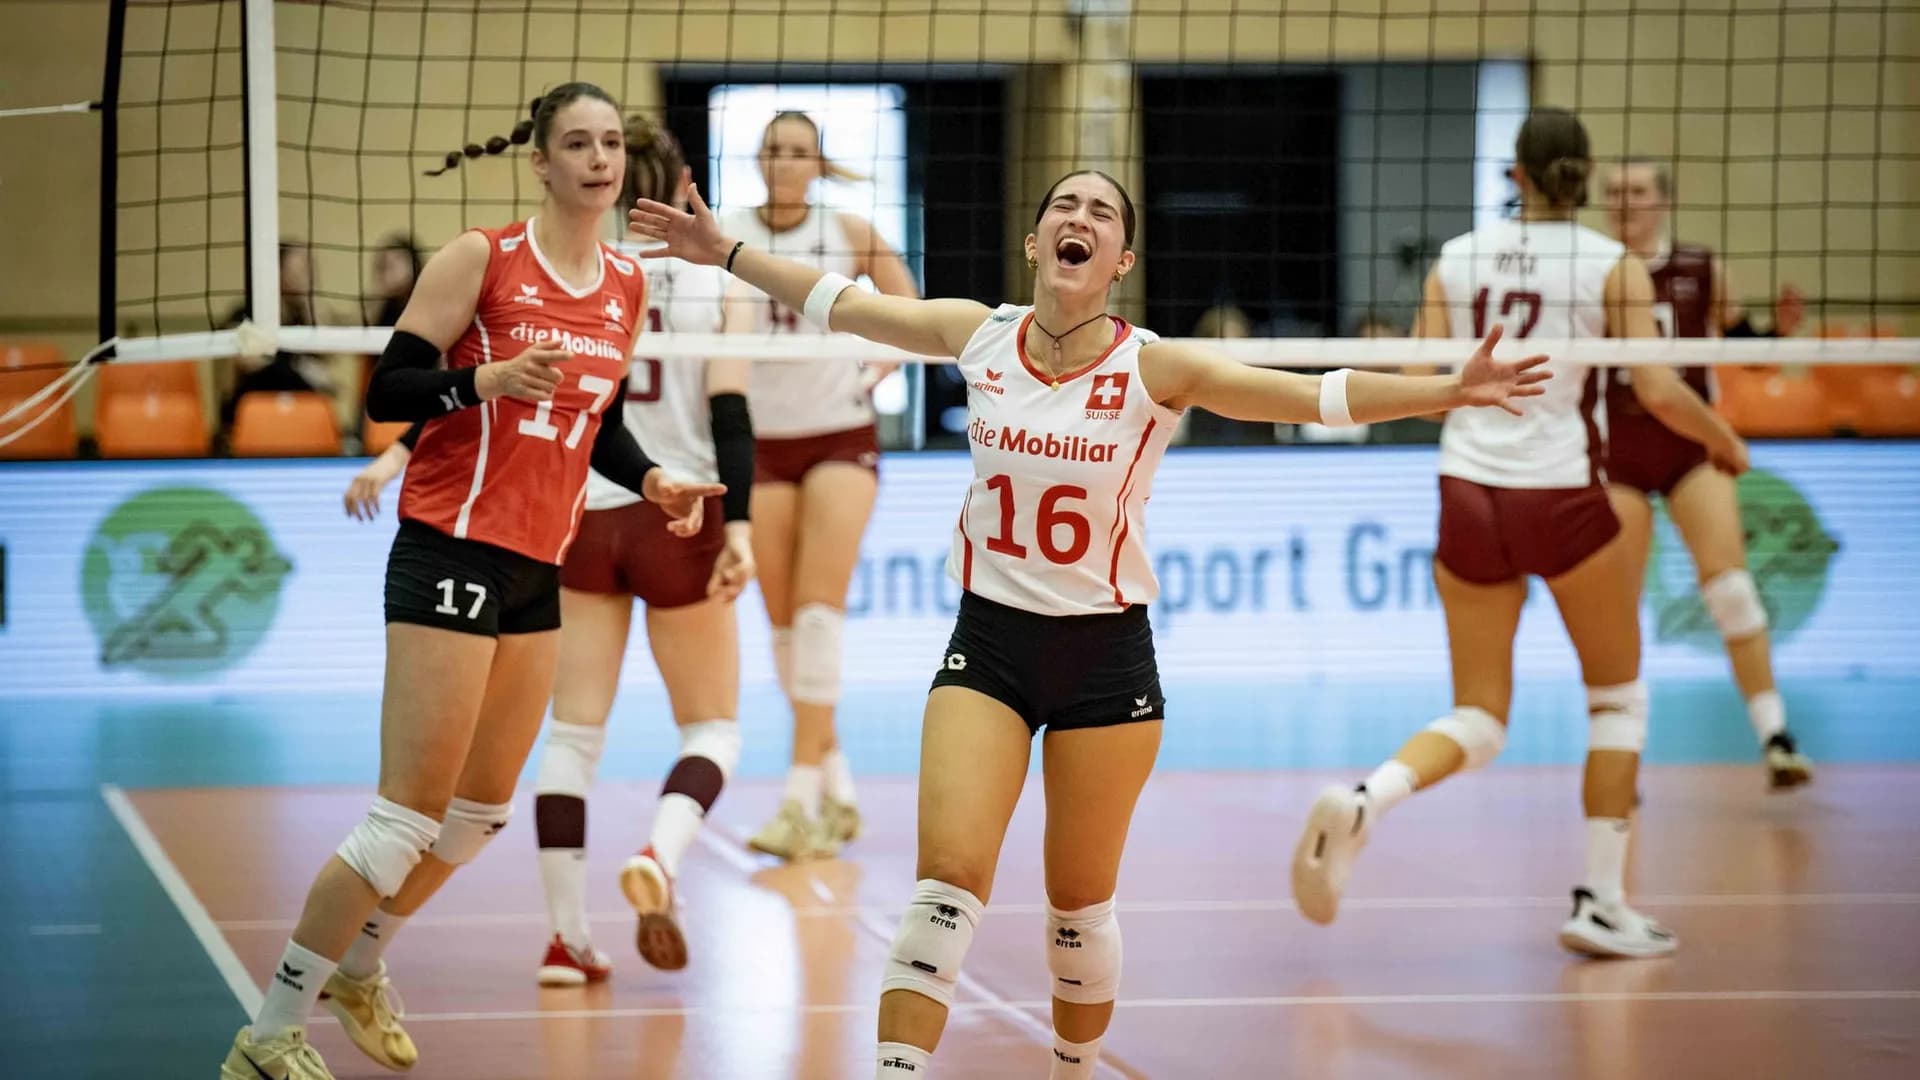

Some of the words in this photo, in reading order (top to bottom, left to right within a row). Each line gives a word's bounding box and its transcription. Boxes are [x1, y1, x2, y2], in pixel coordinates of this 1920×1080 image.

[510, 322, 549, 344] die
[973, 381, 1005, 396] erima
[517, 374, 614, 450] 17
[1085, 410, 1121, 421] SUISSE
[971, 417, 997, 448] die
[998, 426, 1119, 463] Mobiliar
[985, 473, 1091, 566] 16
[1155, 534, 1310, 632] port
[435, 578, 487, 619] 17
[1131, 705, 1153, 718] erima
[930, 914, 957, 930] errea
[1055, 937, 1082, 949] errea
[882, 1057, 916, 1071] erima
